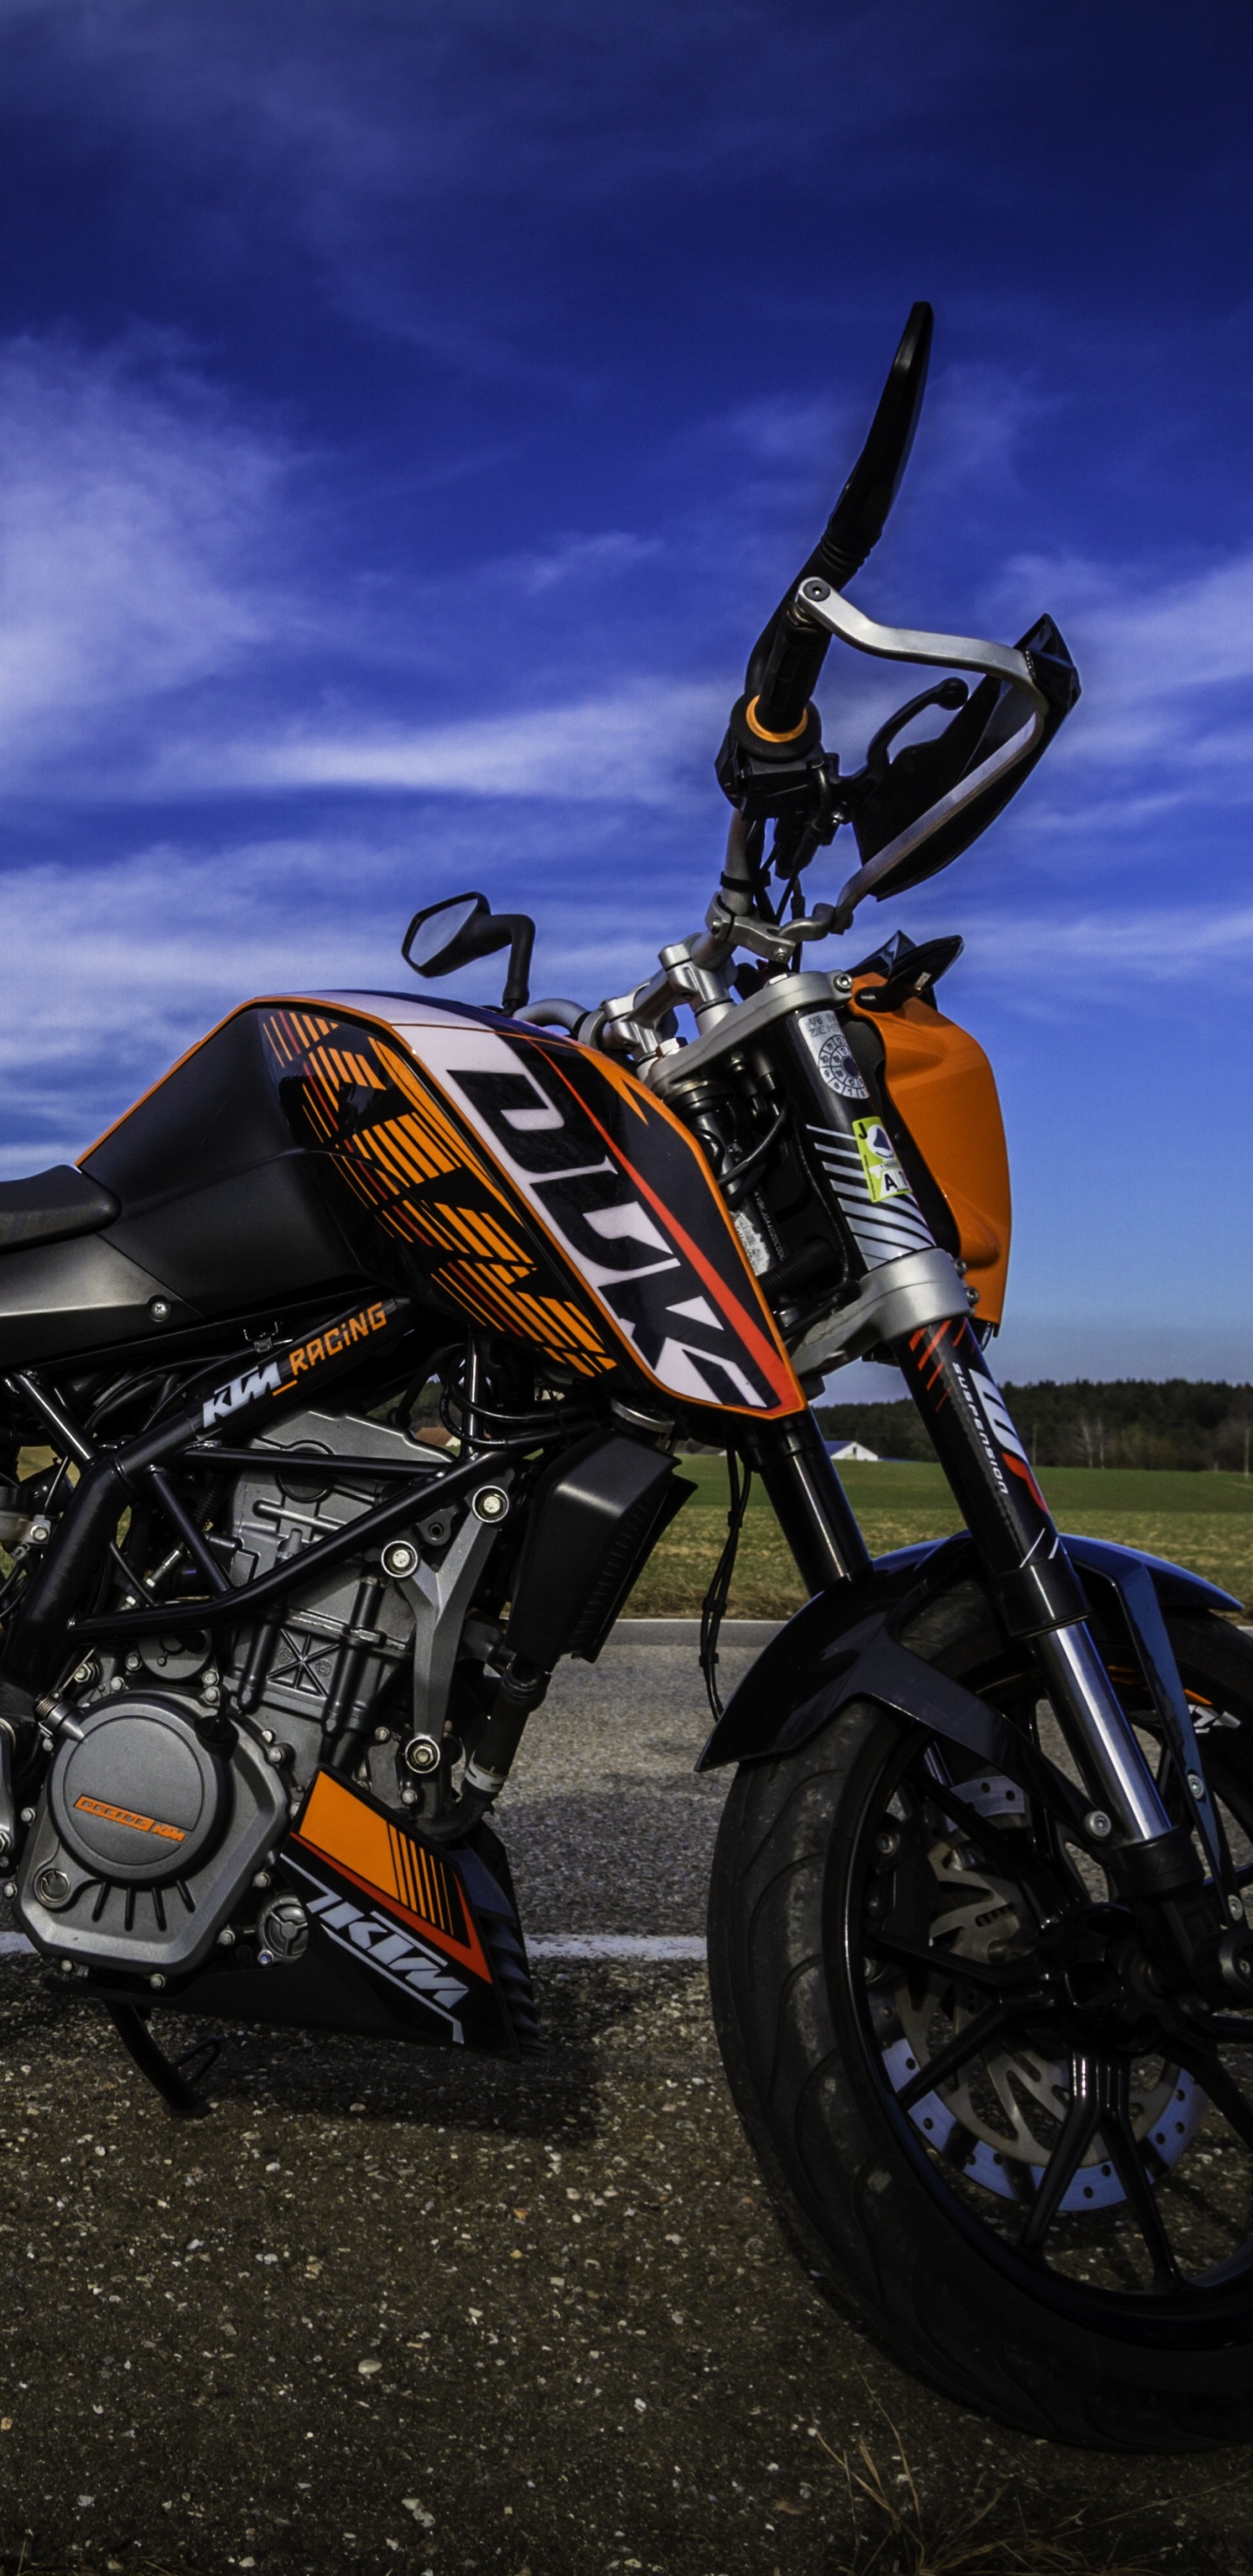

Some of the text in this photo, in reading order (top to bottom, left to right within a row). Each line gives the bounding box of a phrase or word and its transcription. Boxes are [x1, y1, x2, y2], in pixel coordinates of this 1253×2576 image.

[858, 1122, 868, 1139] J
[884, 1173, 898, 1191] A
[952, 1361, 1009, 1495] SUSPENSION
[318, 1901, 469, 2009] KTM
